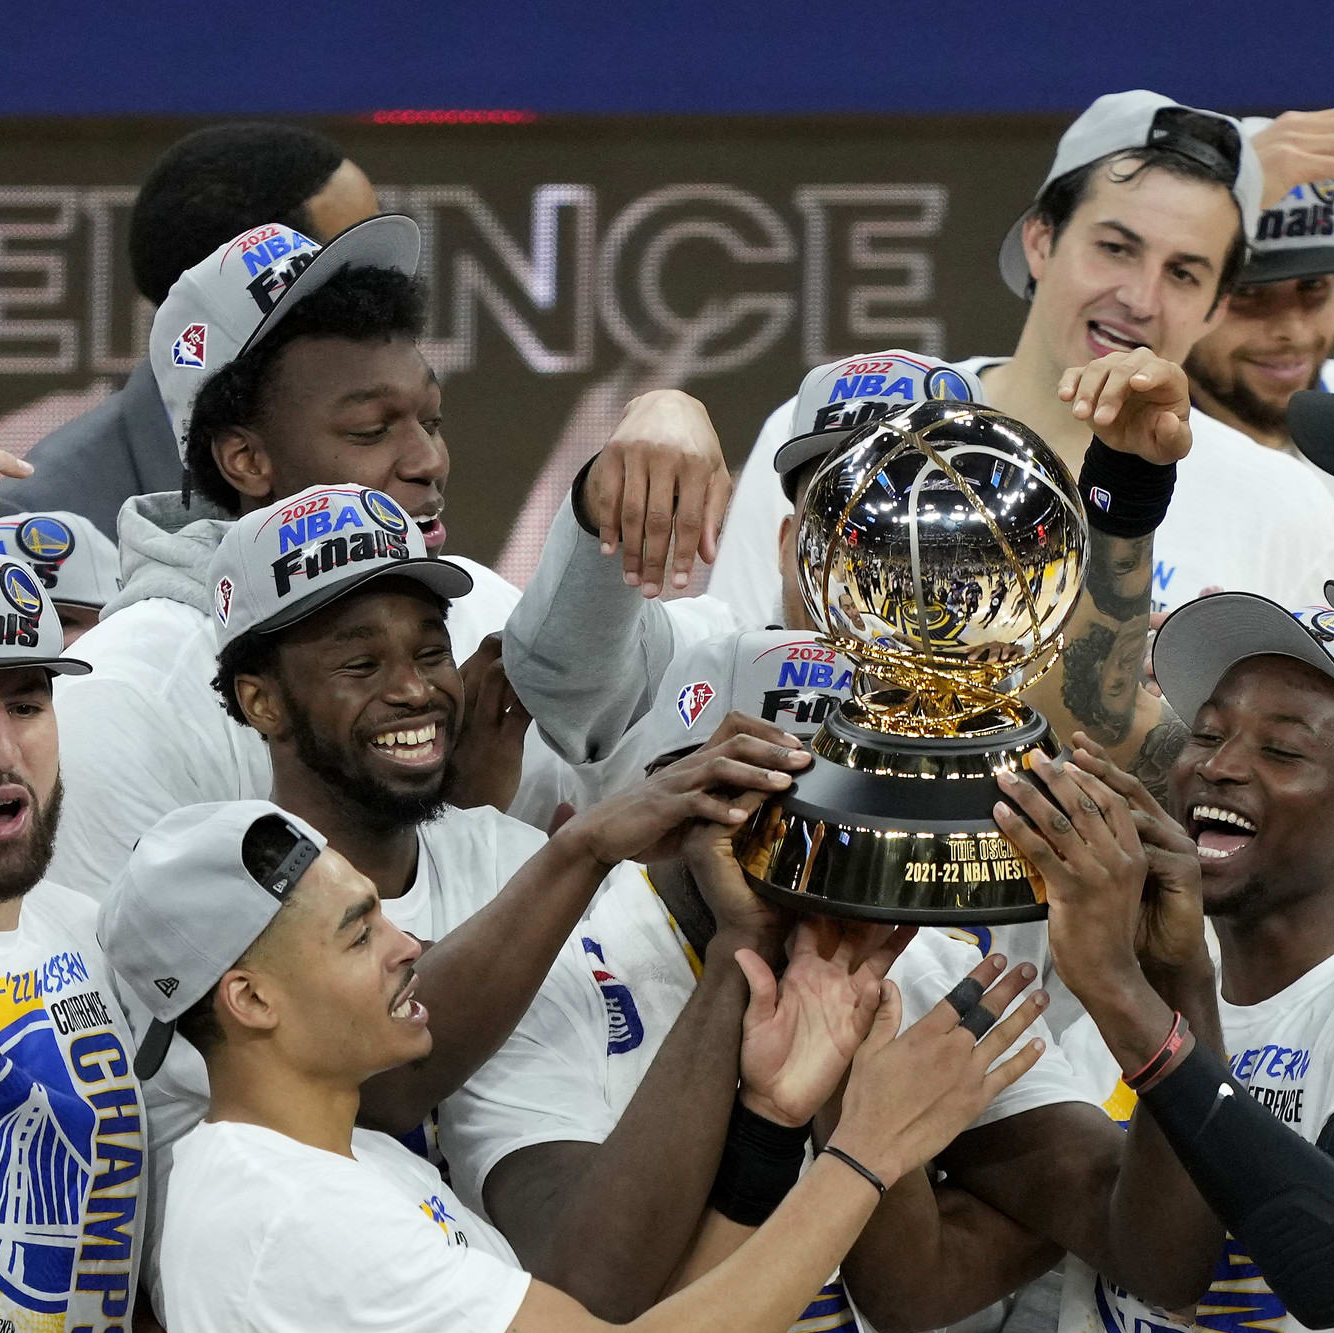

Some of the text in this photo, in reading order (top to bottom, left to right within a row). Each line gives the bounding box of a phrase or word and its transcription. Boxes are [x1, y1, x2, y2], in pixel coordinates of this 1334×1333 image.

[1255, 205, 1334, 240] nals
[237, 227, 281, 253] 2022
[241, 232, 317, 278] NBA
[245, 250, 319, 315] Fin
[841, 362, 894, 376] 2022
[828, 375, 914, 404] NBA
[813, 400, 905, 433] Fin
[282, 496, 329, 525] 2022
[278, 505, 364, 555] NBA
[270, 530, 410, 598] Finals
[786, 647, 836, 664] 2022
[777, 661, 853, 691] NBA
[761, 689, 842, 724] Fin
[949, 838, 1019, 862] THE OSCA
[905, 862, 960, 883] 2021-22
[963, 861, 991, 883] NBA
